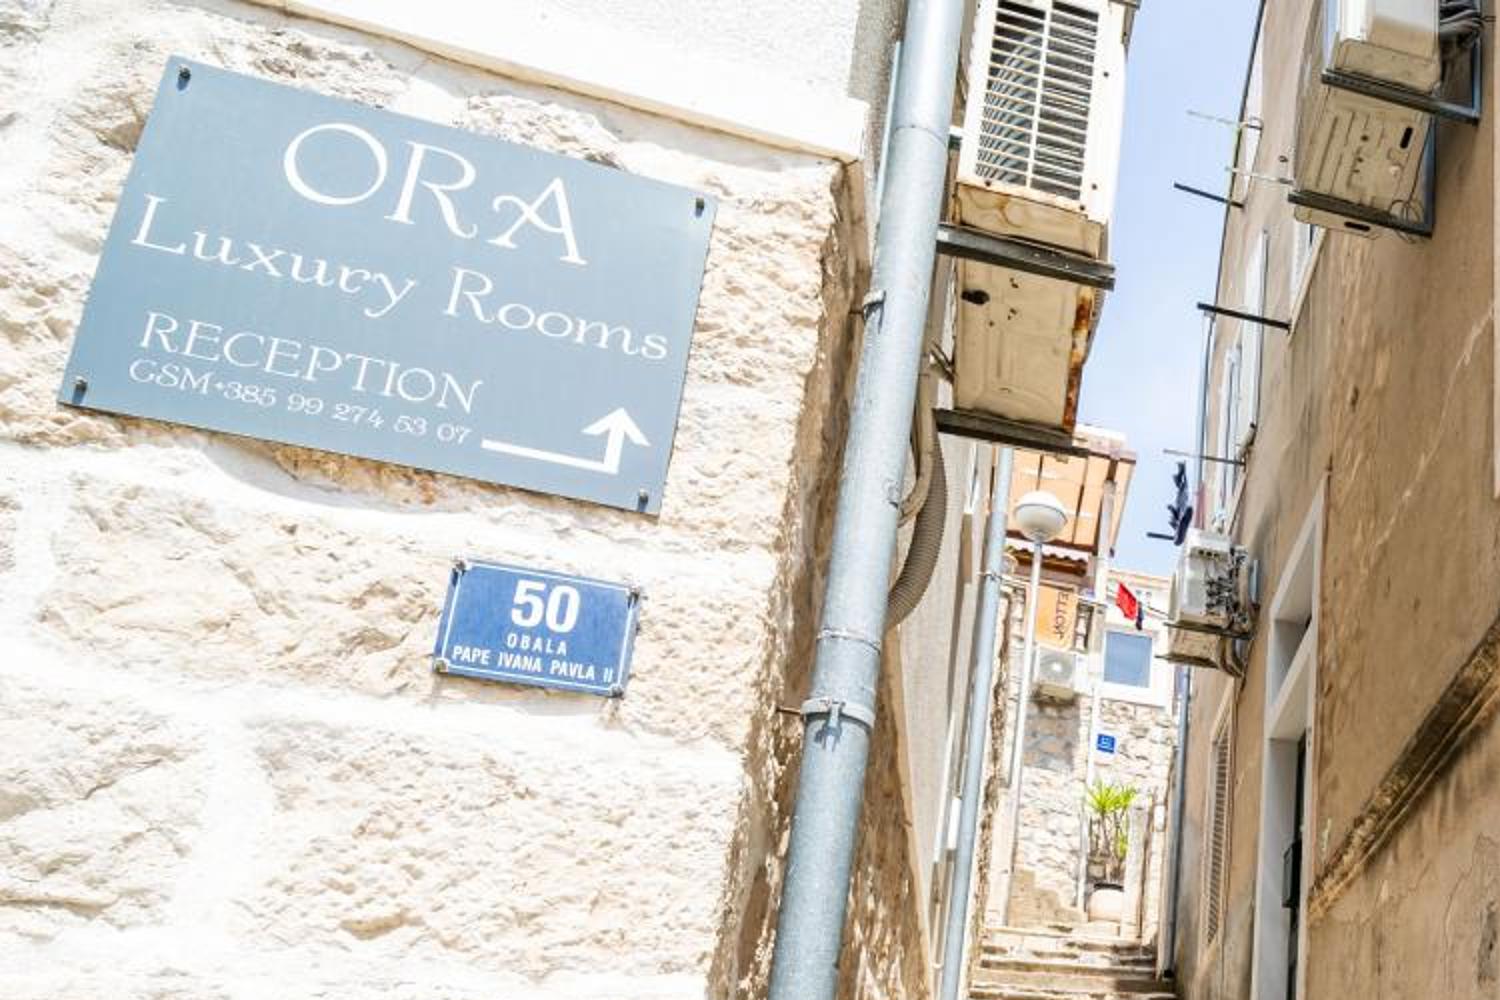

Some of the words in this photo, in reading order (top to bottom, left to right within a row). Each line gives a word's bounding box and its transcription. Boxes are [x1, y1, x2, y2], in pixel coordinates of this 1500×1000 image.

[283, 122, 589, 265] ORA
[130, 193, 417, 318] Luxury
[443, 267, 669, 361] Rooms
[139, 311, 483, 414] RECEPTION
[288, 392, 323, 415] 99
[332, 403, 385, 429] 274
[393, 415, 428, 436] 53
[437, 422, 472, 445] 07
[511, 579, 581, 633] 50
[452, 645, 491, 665] PAPE
[498, 652, 542, 673] IVANA
[550, 659, 595, 681] PAVLA
[603, 667, 613, 683] II
[507, 633, 567, 656] OBALA
